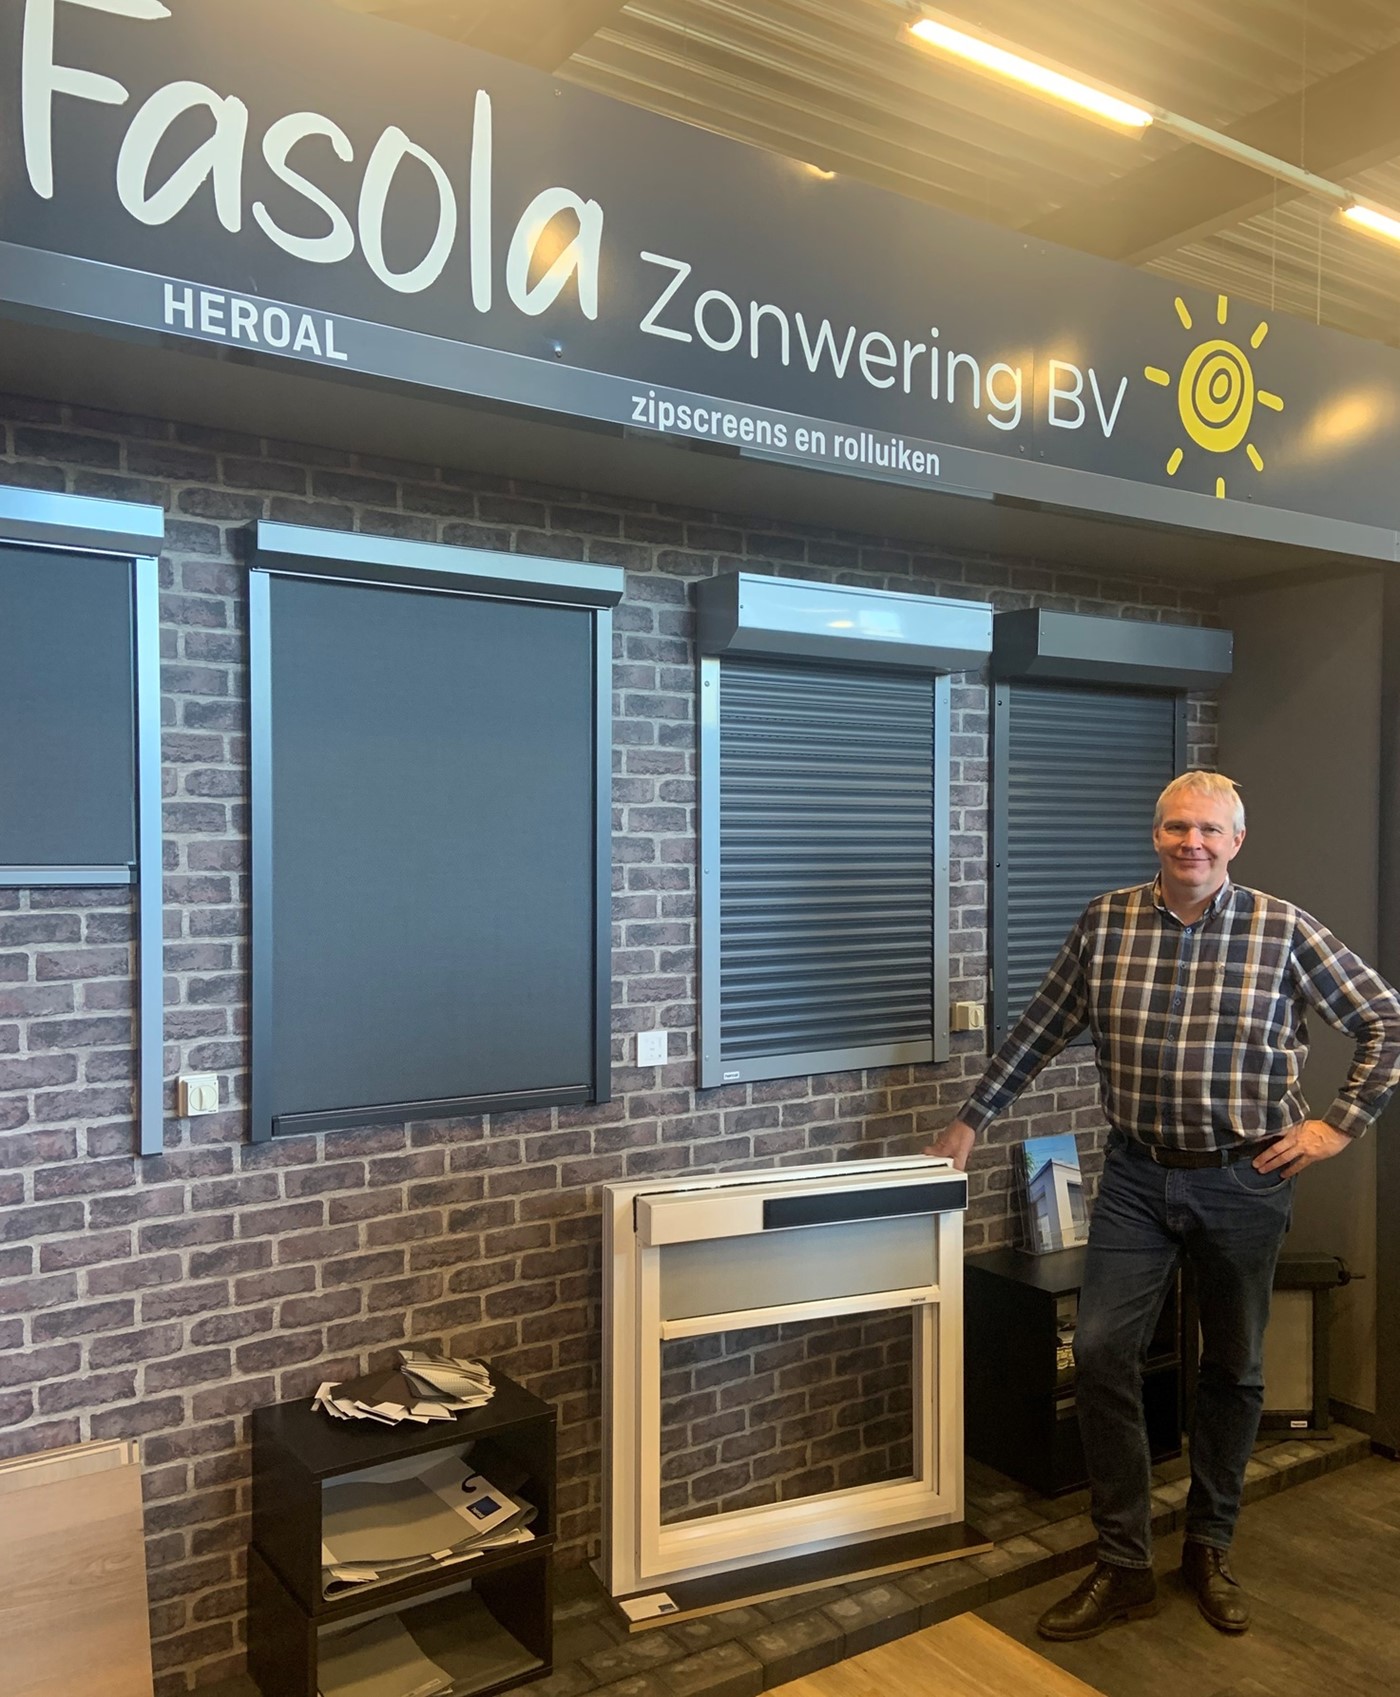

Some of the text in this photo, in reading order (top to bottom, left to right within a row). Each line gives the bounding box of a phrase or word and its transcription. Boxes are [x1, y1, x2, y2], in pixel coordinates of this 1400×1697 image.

[22, 0, 604, 320] Fasola
[164, 283, 348, 362] HEROAL
[640, 250, 1128, 438] Zonwering BV
[631, 390, 940, 476] zipscreens en rolluiken
